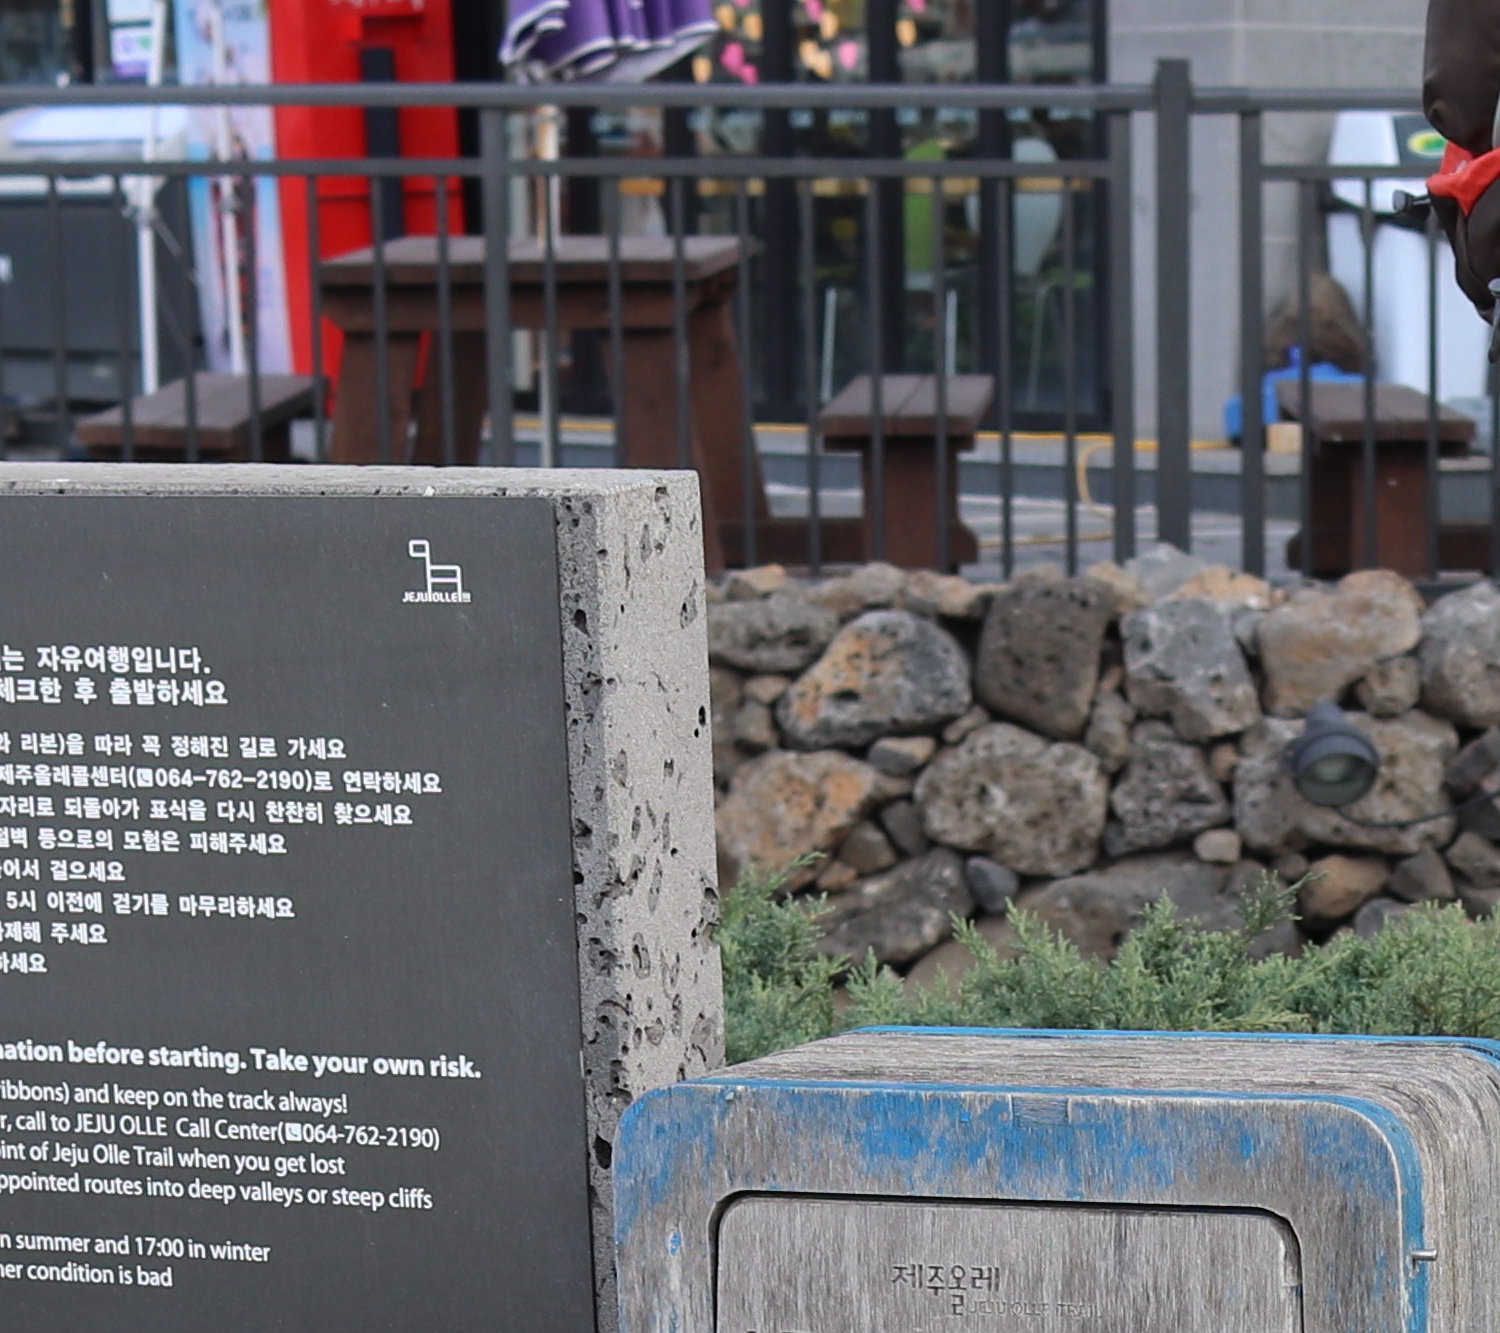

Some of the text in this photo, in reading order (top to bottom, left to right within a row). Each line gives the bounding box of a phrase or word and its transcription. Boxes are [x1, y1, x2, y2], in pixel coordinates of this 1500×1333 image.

[37, 645, 211, 674] 자유여행입니다.
[74, 677, 98, 705] 후
[109, 677, 228, 707] 출발하세요
[67, 1039, 145, 1065] before
[148, 1045, 247, 1075] starting.
[249, 1047, 309, 1072] Take
[311, 1055, 369, 1078] your
[373, 1057, 425, 1076] own
[430, 1054, 481, 1079] risk.
[15, 1234, 91, 1253] summer
[94, 1234, 130, 1255] and
[135, 1236, 184, 1258] 17:00
[187, 1238, 206, 1259] in
[209, 1240, 271, 1262] winter
[891, 1263, 1000, 1317] 제주올레
